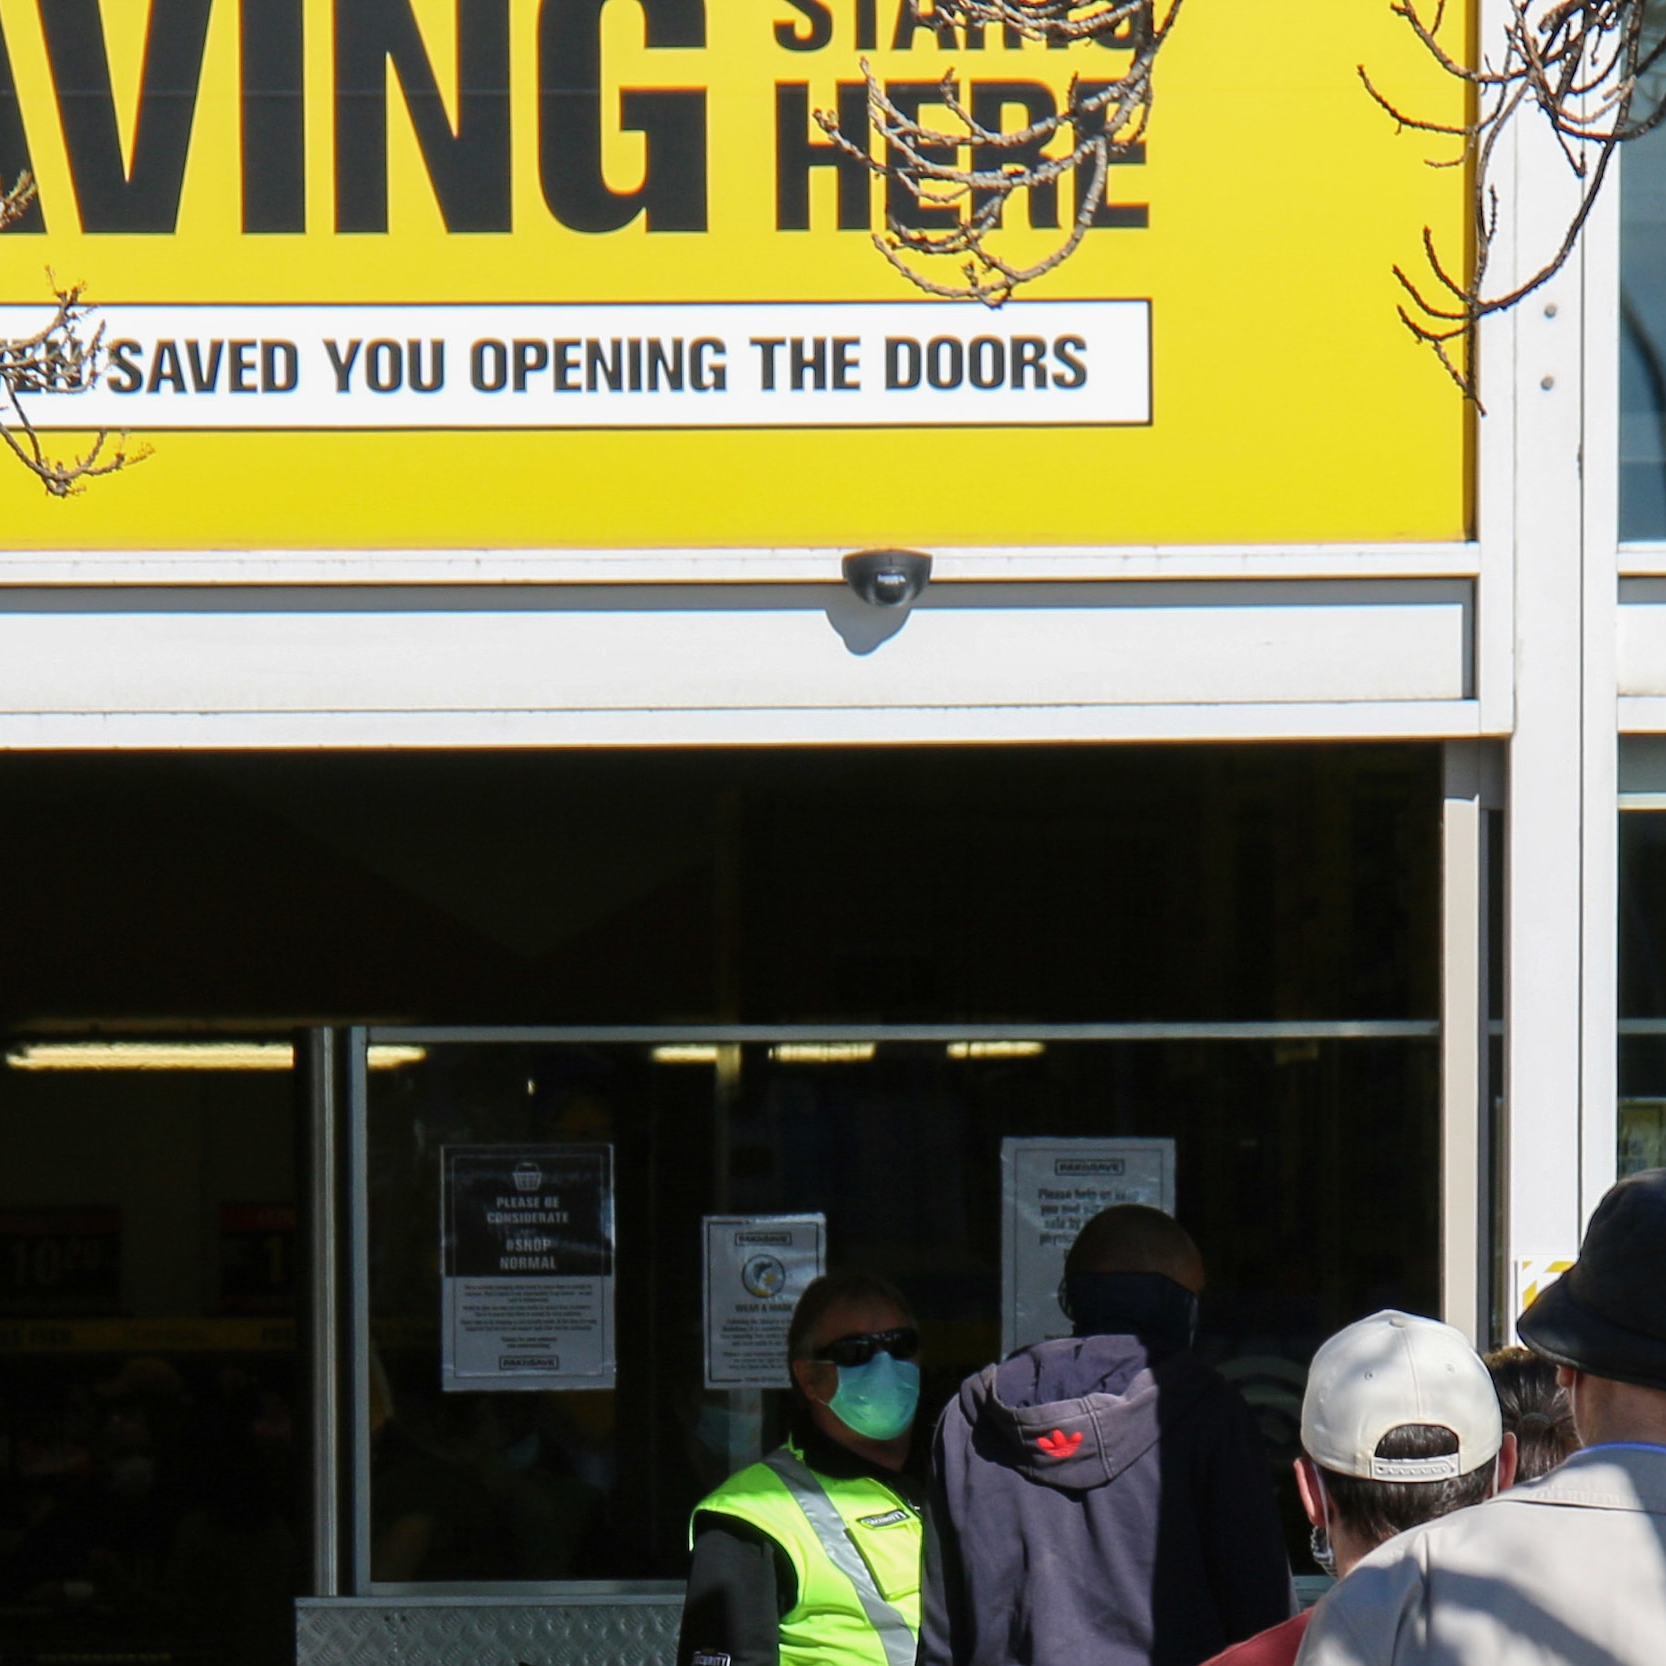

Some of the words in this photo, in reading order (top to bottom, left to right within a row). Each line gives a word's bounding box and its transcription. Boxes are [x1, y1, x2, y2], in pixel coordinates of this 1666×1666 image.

[775, 79, 1150, 231] HERE
[107, 338, 299, 394] SAVED
[321, 337, 445, 393] YOU
[470, 336, 728, 393] OPENING
[749, 336, 861, 391] THE
[884, 334, 1088, 391] DOORS
[496, 1196, 541, 1208] PLEASE
[544, 1196, 560, 1208] BE
[486, 1211, 570, 1224] CONSIDERATE
[499, 1256, 557, 1270] NORMAL
